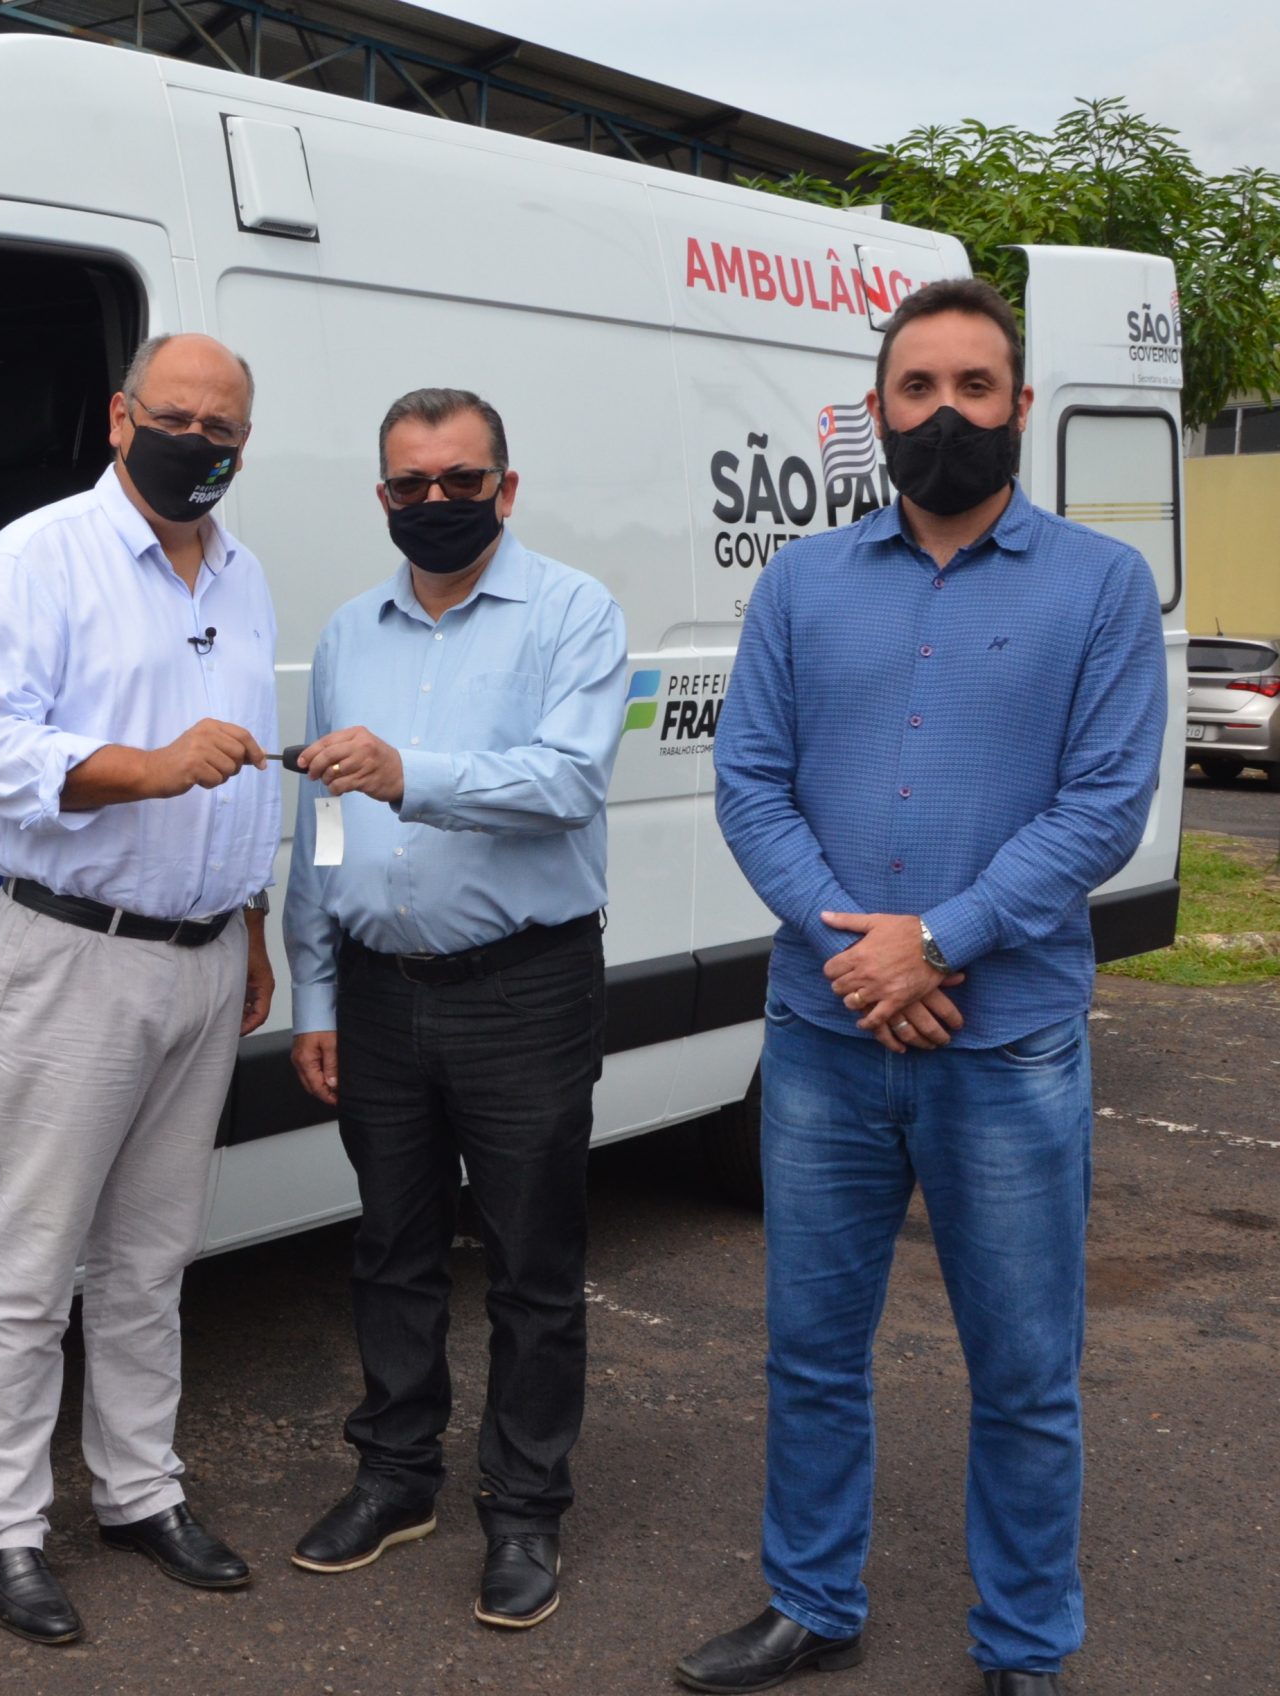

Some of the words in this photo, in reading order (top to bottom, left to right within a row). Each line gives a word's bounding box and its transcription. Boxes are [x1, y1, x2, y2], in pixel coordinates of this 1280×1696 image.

[687, 236, 928, 315] AMBULÂNC
[1127, 303, 1170, 345] SÃO
[1129, 345, 1179, 364] GOVERNO
[710, 432, 817, 527] SÃO
